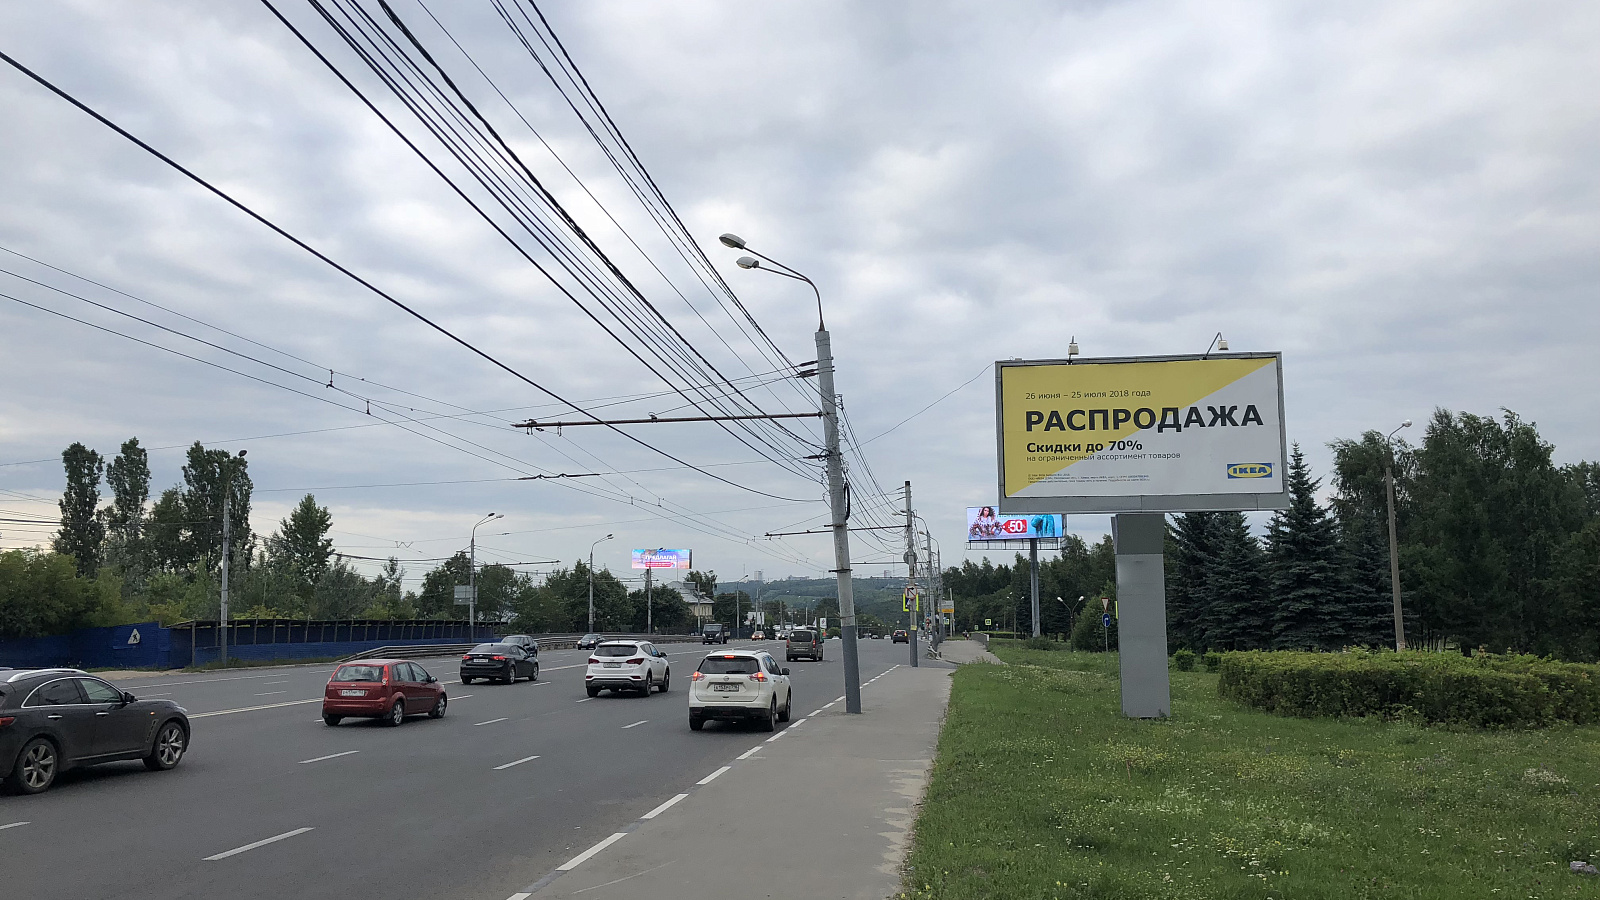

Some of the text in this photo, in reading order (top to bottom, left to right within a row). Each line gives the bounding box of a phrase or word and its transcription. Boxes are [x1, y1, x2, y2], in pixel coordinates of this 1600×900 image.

[1025, 392, 1036, 400] 26
[1038, 392, 1061, 400] июня
[1071, 391, 1082, 399] 25
[1109, 389, 1130, 398] 2018
[1131, 390, 1151, 398] года
[1025, 404, 1264, 433] РАСПРОДАЖА
[1026, 440, 1143, 454] Скидки до 70%
[1038, 453, 1095, 462] ограниченный
[1097, 453, 1146, 462] ассортимент
[1149, 452, 1181, 461] товаров
[1232, 466, 1269, 475] IKEA
